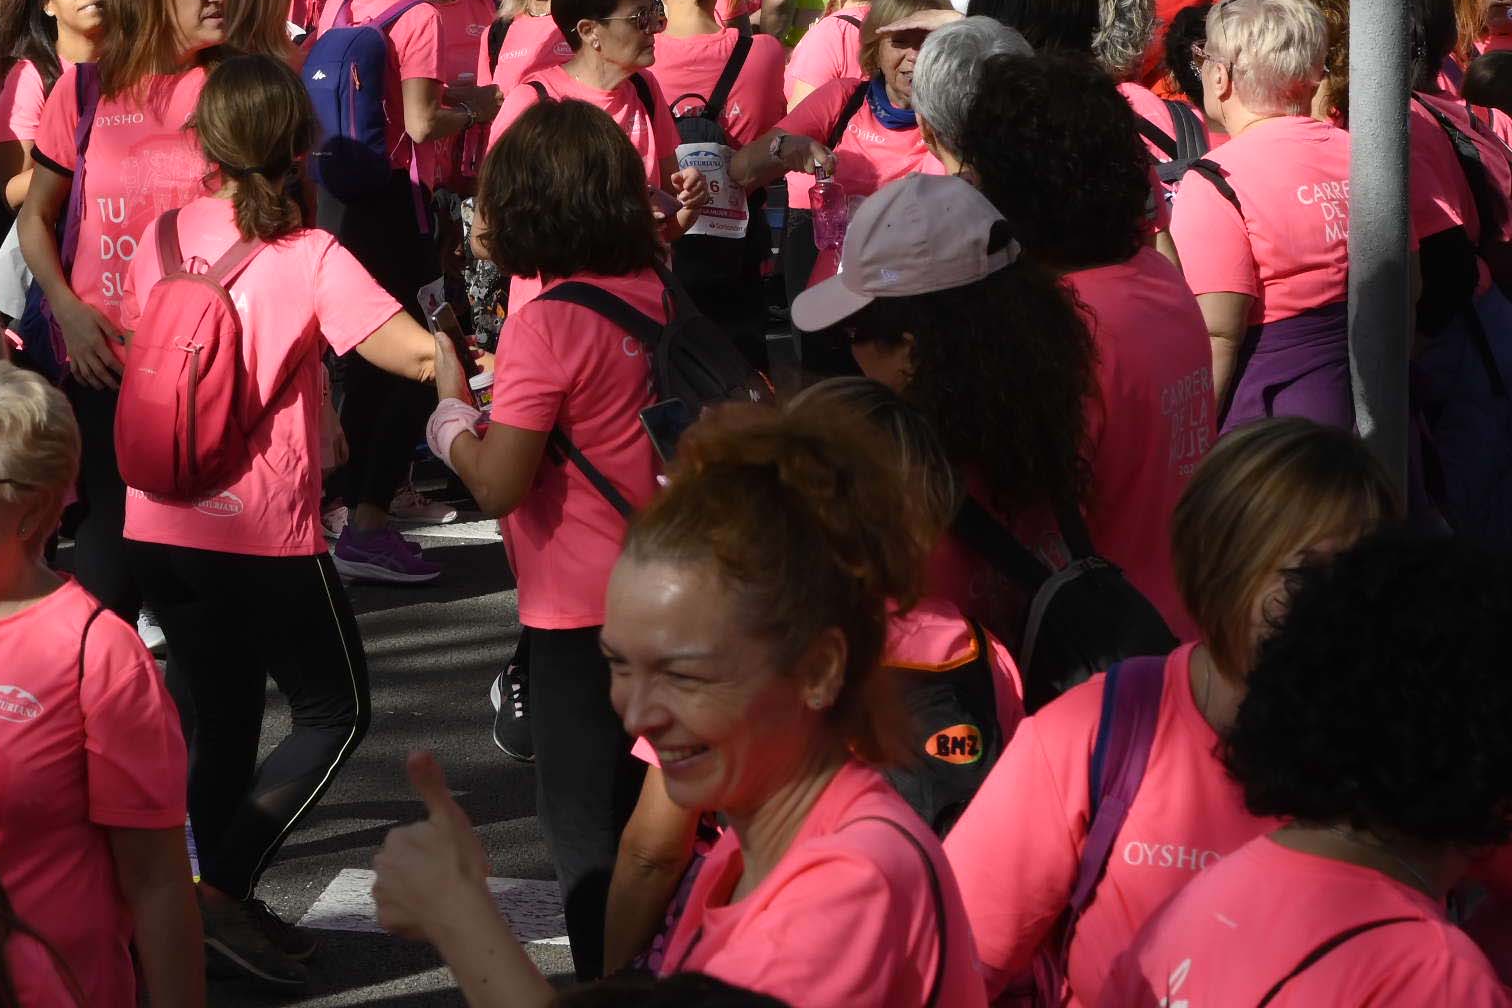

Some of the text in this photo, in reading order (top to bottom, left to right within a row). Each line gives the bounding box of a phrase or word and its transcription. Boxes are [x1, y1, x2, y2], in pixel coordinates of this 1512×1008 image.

[96, 113, 144, 127] OYSHO
[1296, 179, 1349, 205] CARRE
[96, 197, 125, 224] TU
[1321, 202, 1346, 221] DE
